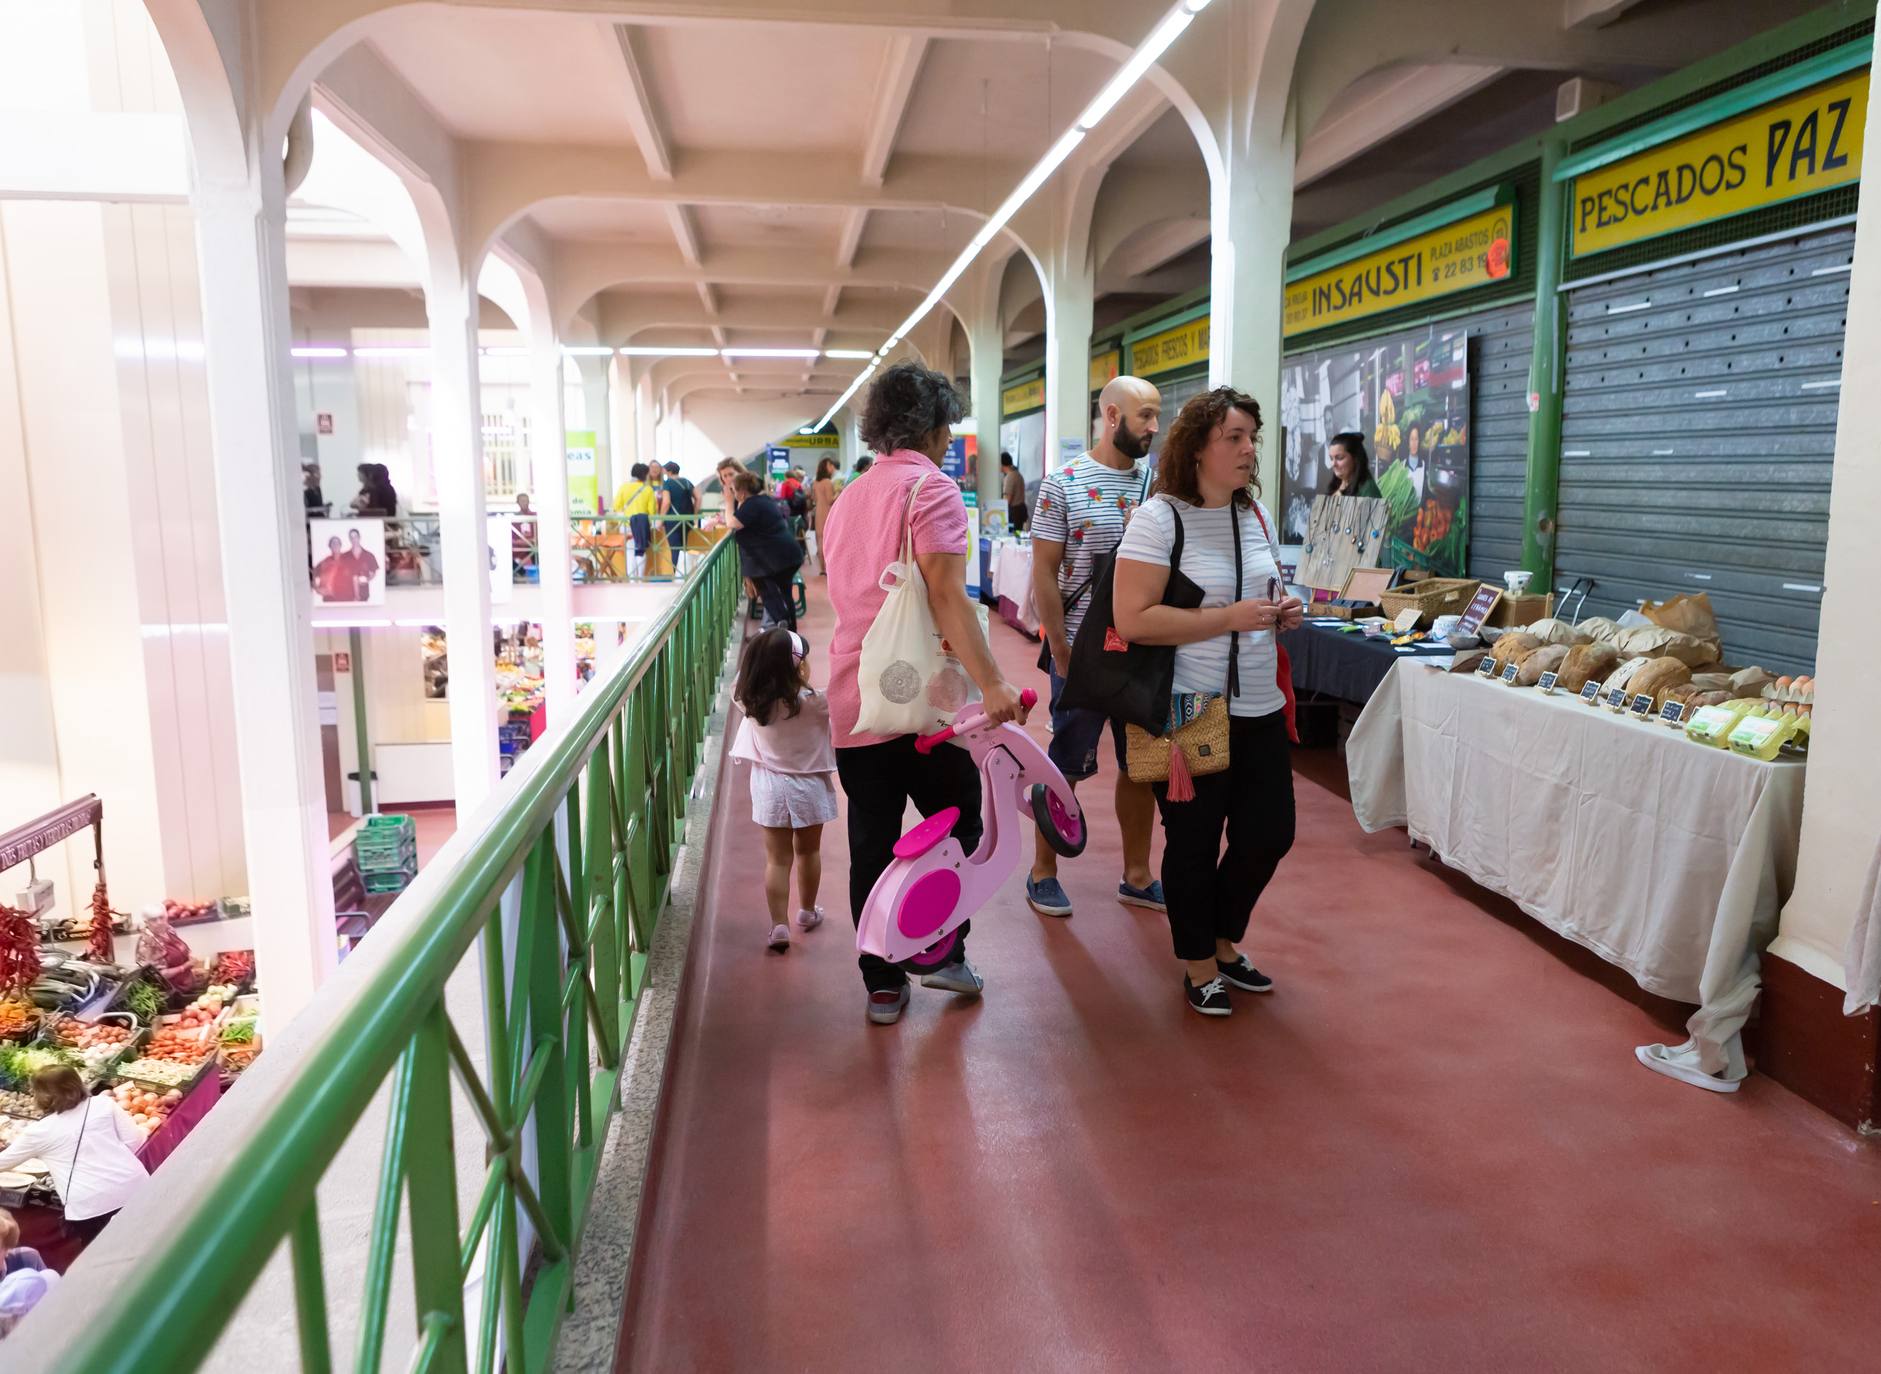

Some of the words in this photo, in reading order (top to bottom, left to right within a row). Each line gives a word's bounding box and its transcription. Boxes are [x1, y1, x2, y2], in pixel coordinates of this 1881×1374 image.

[1578, 144, 1748, 234] PESCADOS
[1765, 97, 1852, 188] PAZ
[1431, 241, 1453, 262] PLAZA
[1444, 262, 1457, 278] 22
[1459, 256, 1474, 274] 83
[1312, 252, 1423, 317] INSAUSTI
